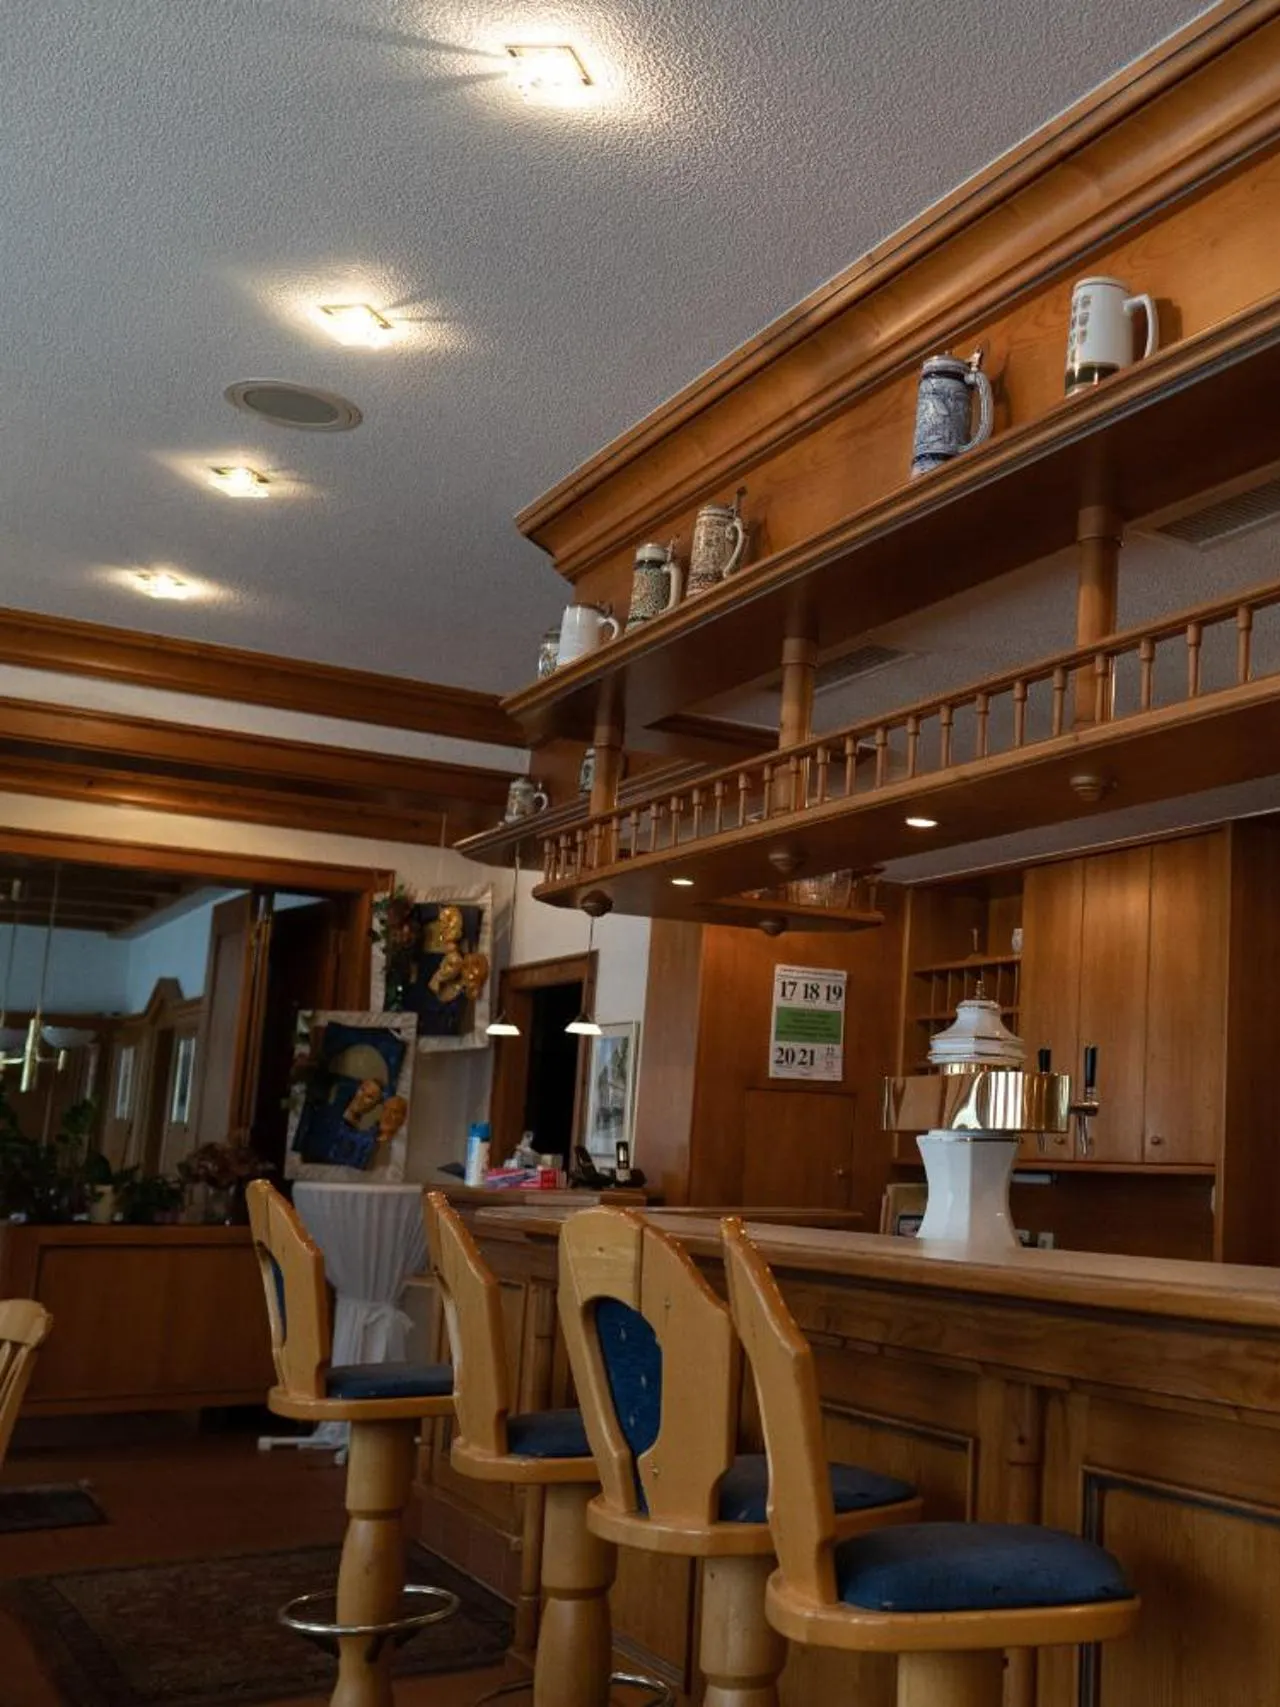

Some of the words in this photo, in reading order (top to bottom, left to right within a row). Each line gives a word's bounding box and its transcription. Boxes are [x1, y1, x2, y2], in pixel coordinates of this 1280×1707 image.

[780, 980, 797, 998] 17
[803, 982, 820, 1000] 18
[825, 984, 843, 1002] 19
[775, 1047, 795, 1065] 20
[798, 1048, 815, 1066] 21
